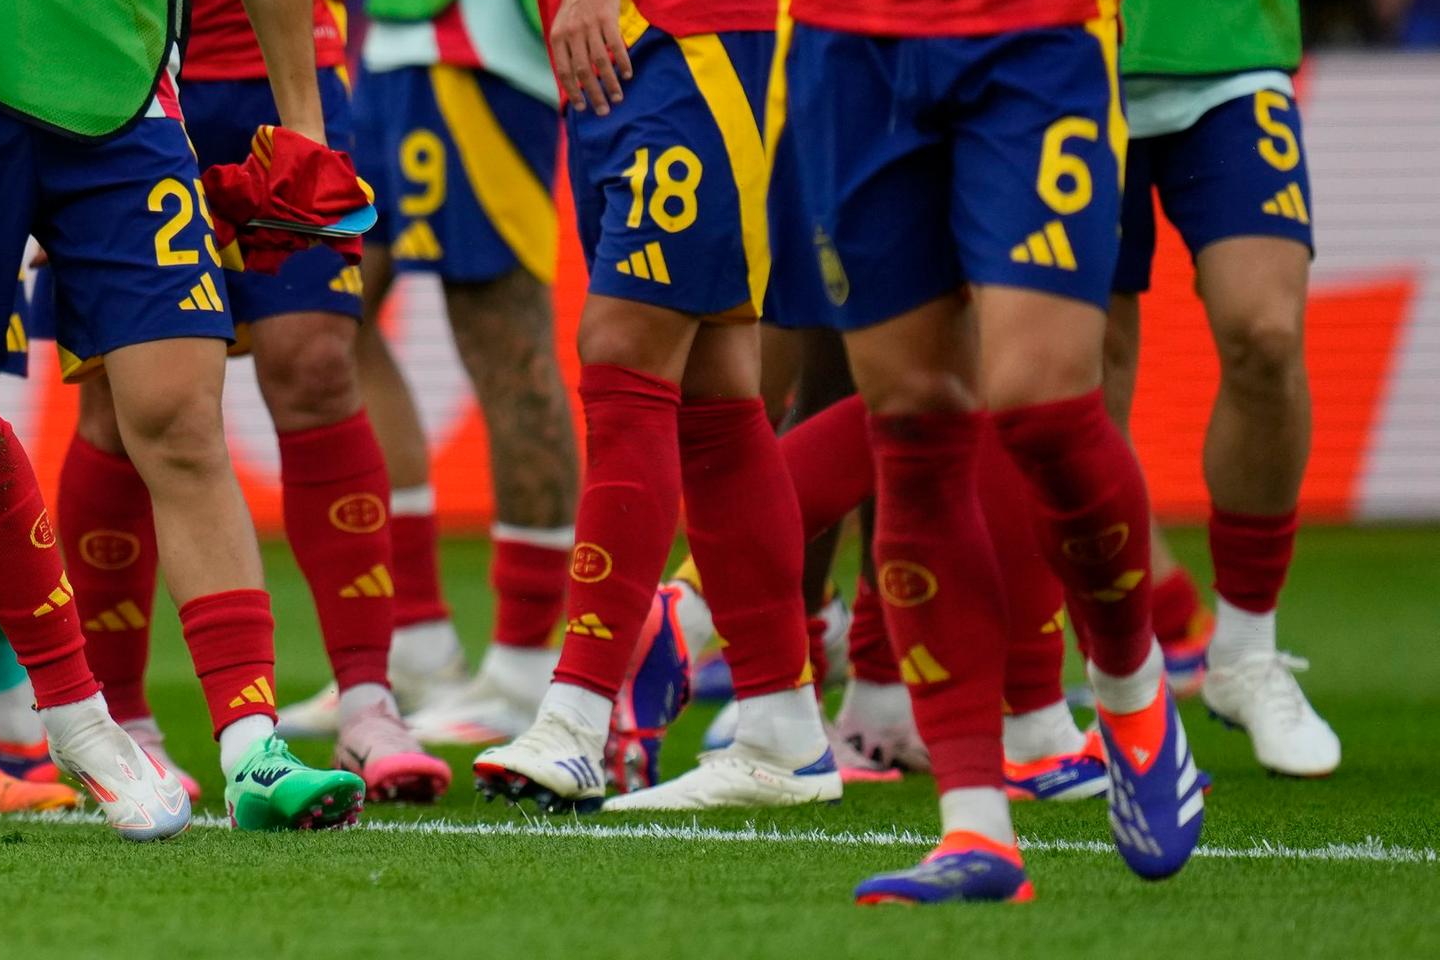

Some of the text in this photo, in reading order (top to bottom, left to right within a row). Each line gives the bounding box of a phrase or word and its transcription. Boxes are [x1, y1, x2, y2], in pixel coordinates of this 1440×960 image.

[399, 128, 447, 216] 9
[1037, 116, 1099, 214] 6
[1253, 89, 1300, 172] 5
[622, 145, 704, 233] 18
